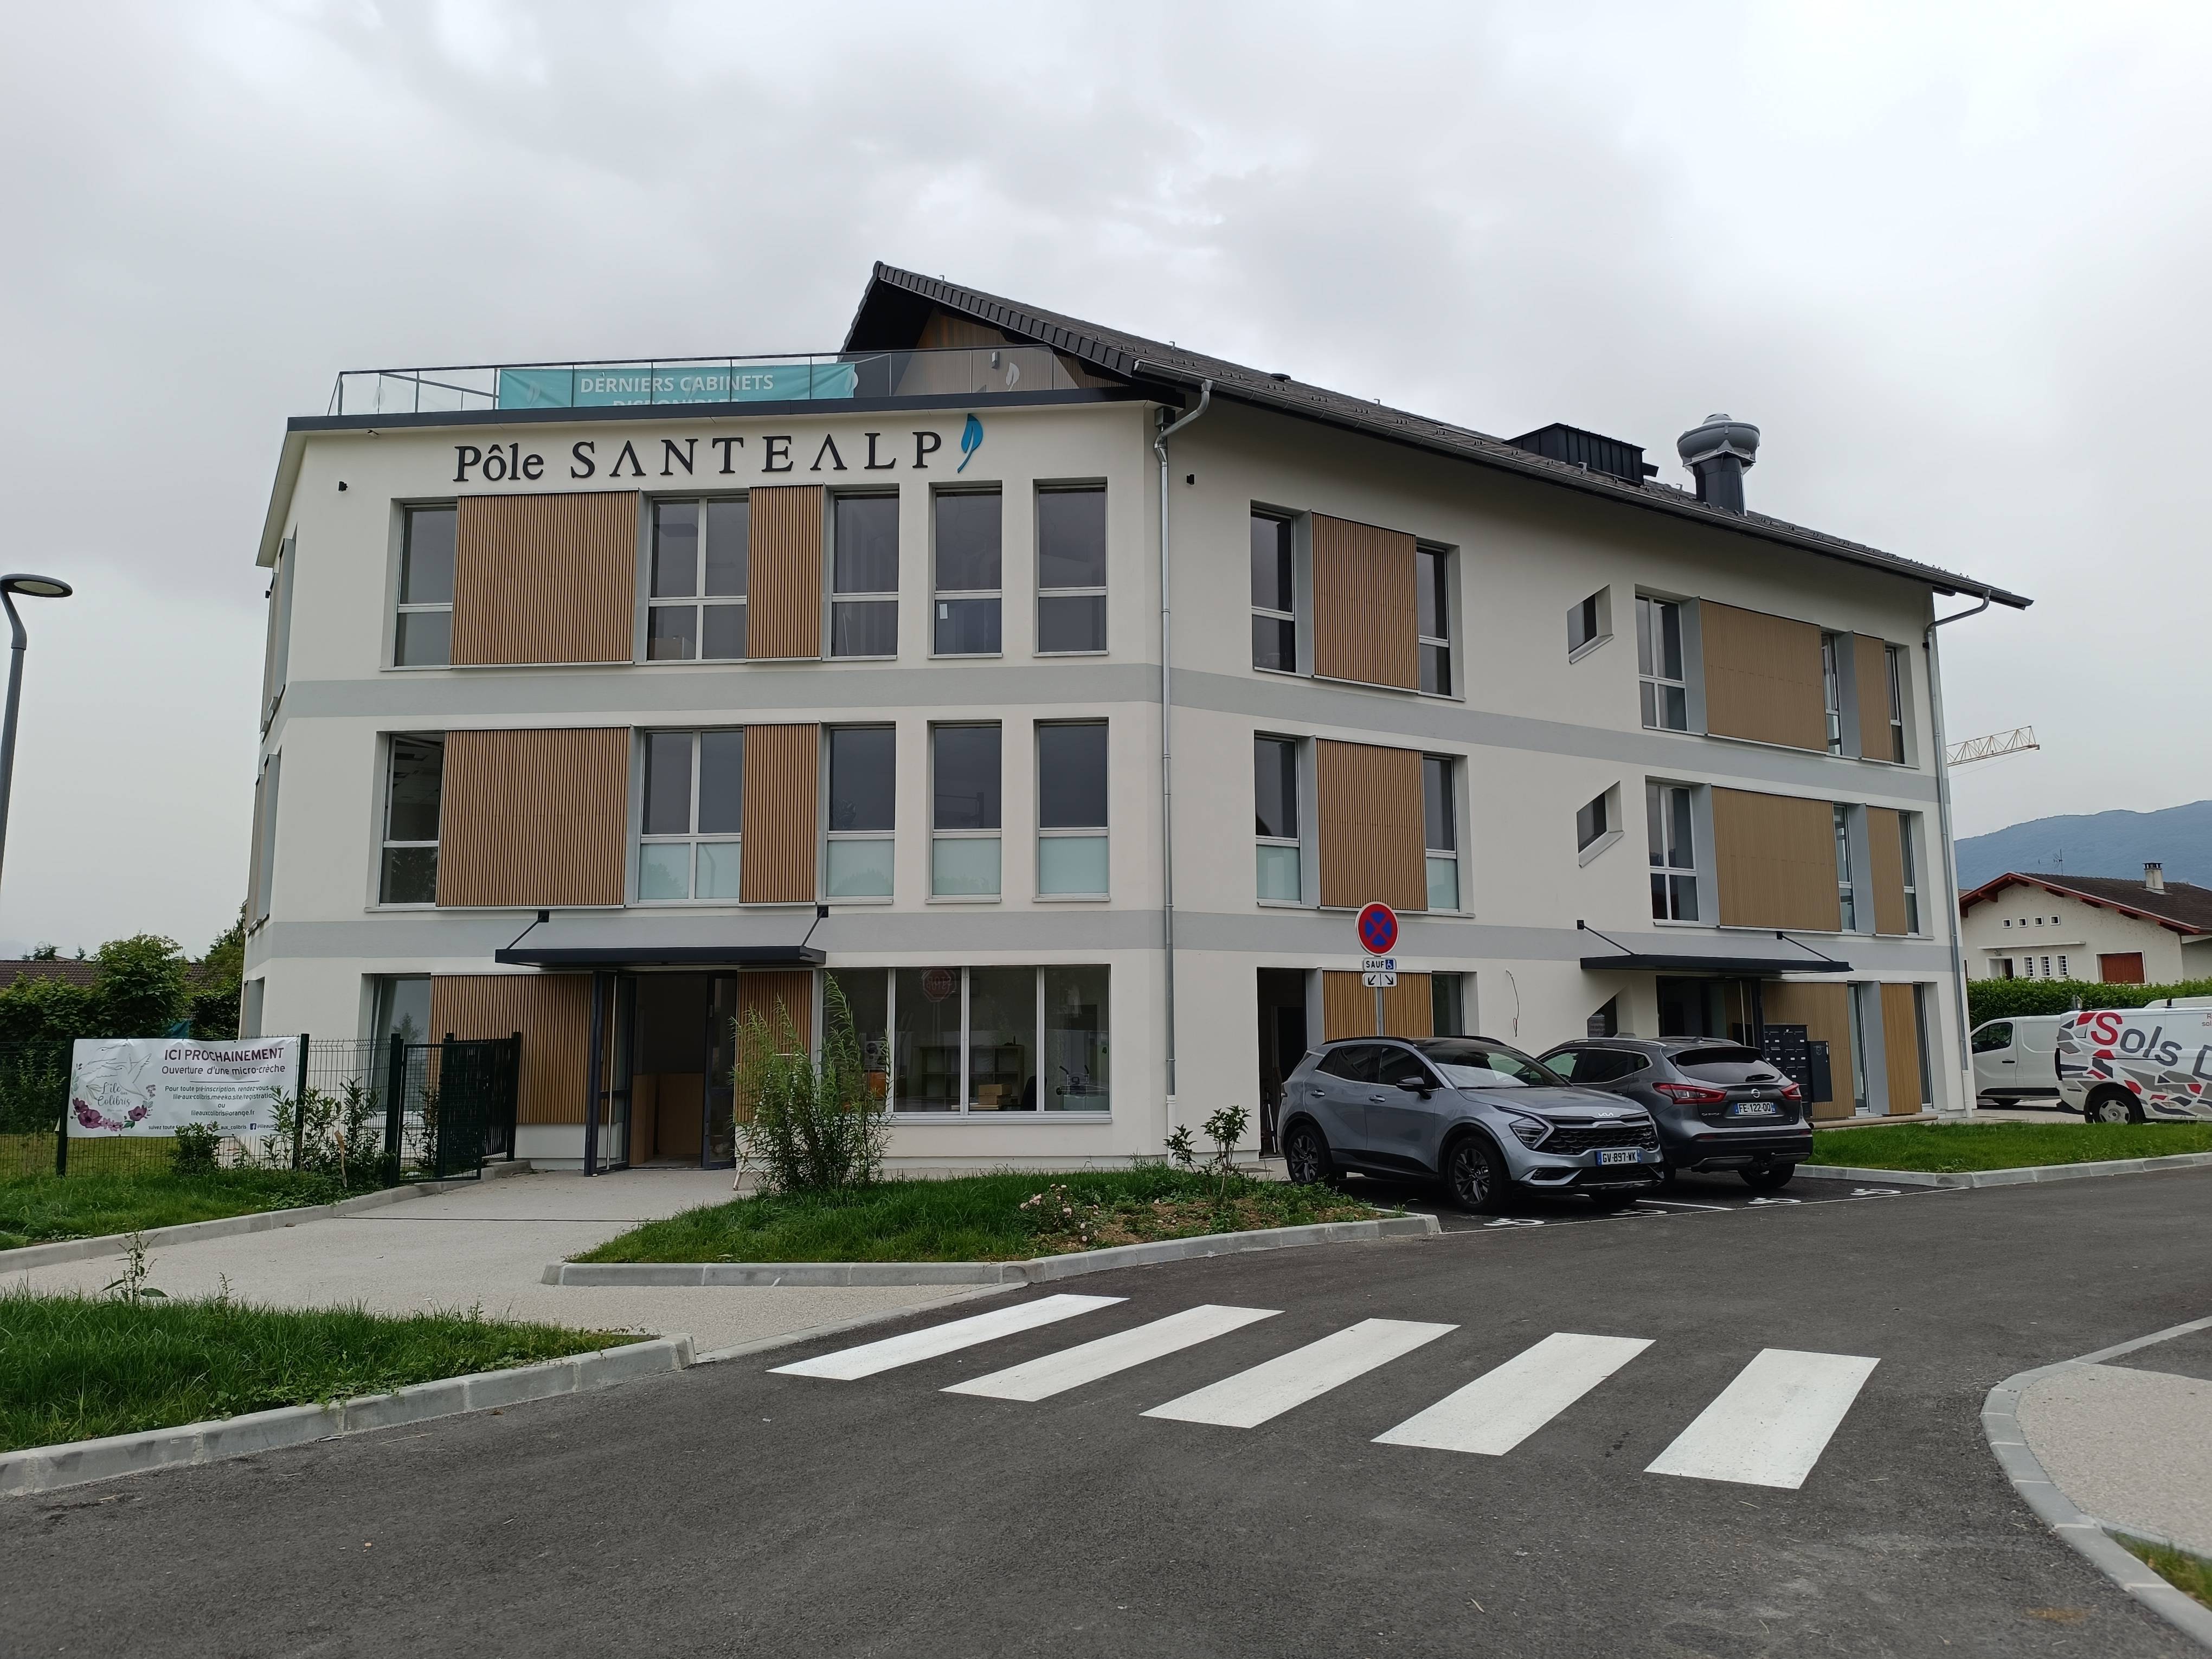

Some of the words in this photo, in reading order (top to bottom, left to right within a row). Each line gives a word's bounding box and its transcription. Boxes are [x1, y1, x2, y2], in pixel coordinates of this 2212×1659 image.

[580, 377, 674, 393] DERNIERS
[679, 374, 774, 391] CABINETS
[453, 441, 544, 483] Pôle
[569, 430, 942, 479] SANTEALP
[2090, 1011, 2182, 1066] Sols
[164, 1049, 181, 1060] ICI
[185, 1047, 284, 1062] PROCHAINEMENT
[162, 1066, 203, 1075] Ouverture
[207, 1065, 229, 1075] d'une
[232, 1064, 285, 1075] micro-crèche
[97, 1095, 131, 1107] Colibris
[1602, 1152, 1636, 1163] GV-897-WK
